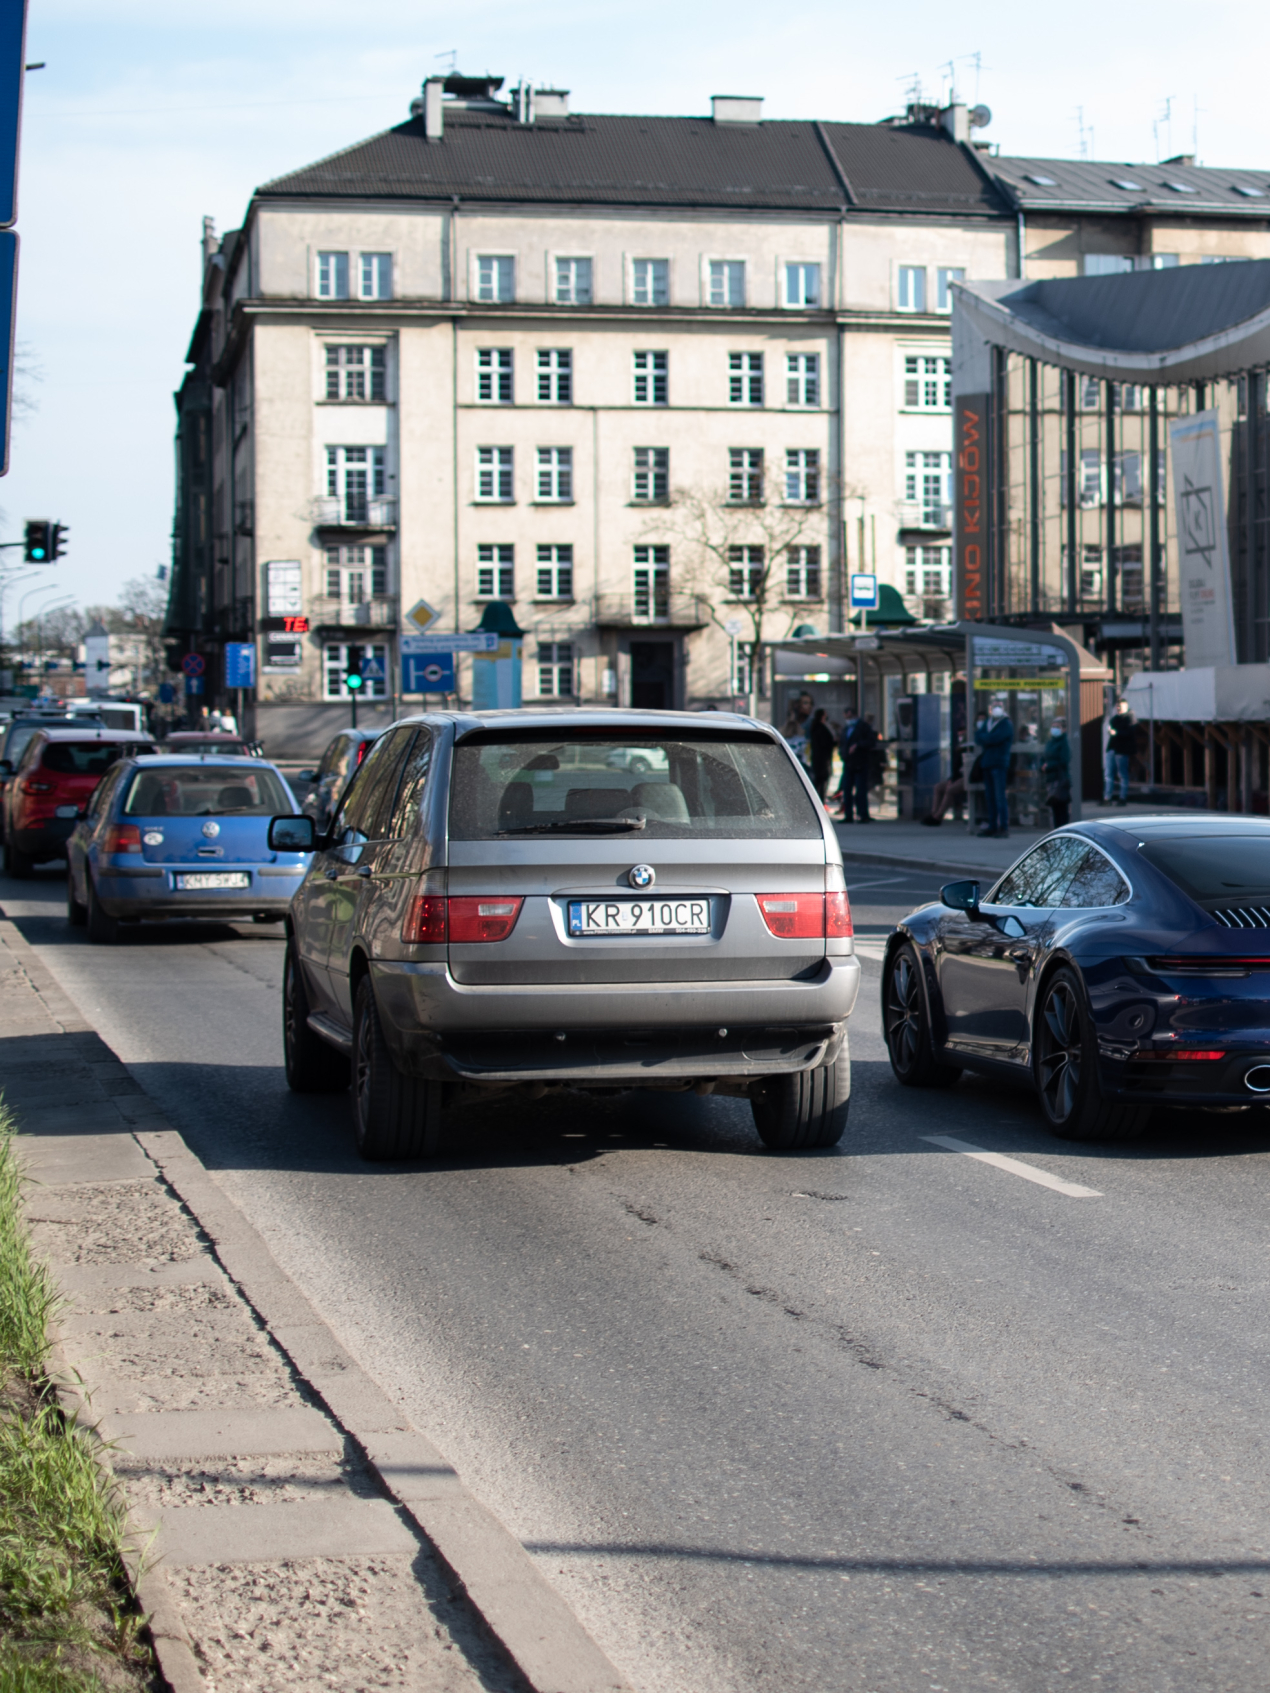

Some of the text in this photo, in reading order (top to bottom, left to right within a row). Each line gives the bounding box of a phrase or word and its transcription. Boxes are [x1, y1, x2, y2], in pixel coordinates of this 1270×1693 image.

[959, 409, 981, 534] KIJÓW
[572, 903, 704, 928] PL KR 910CR
